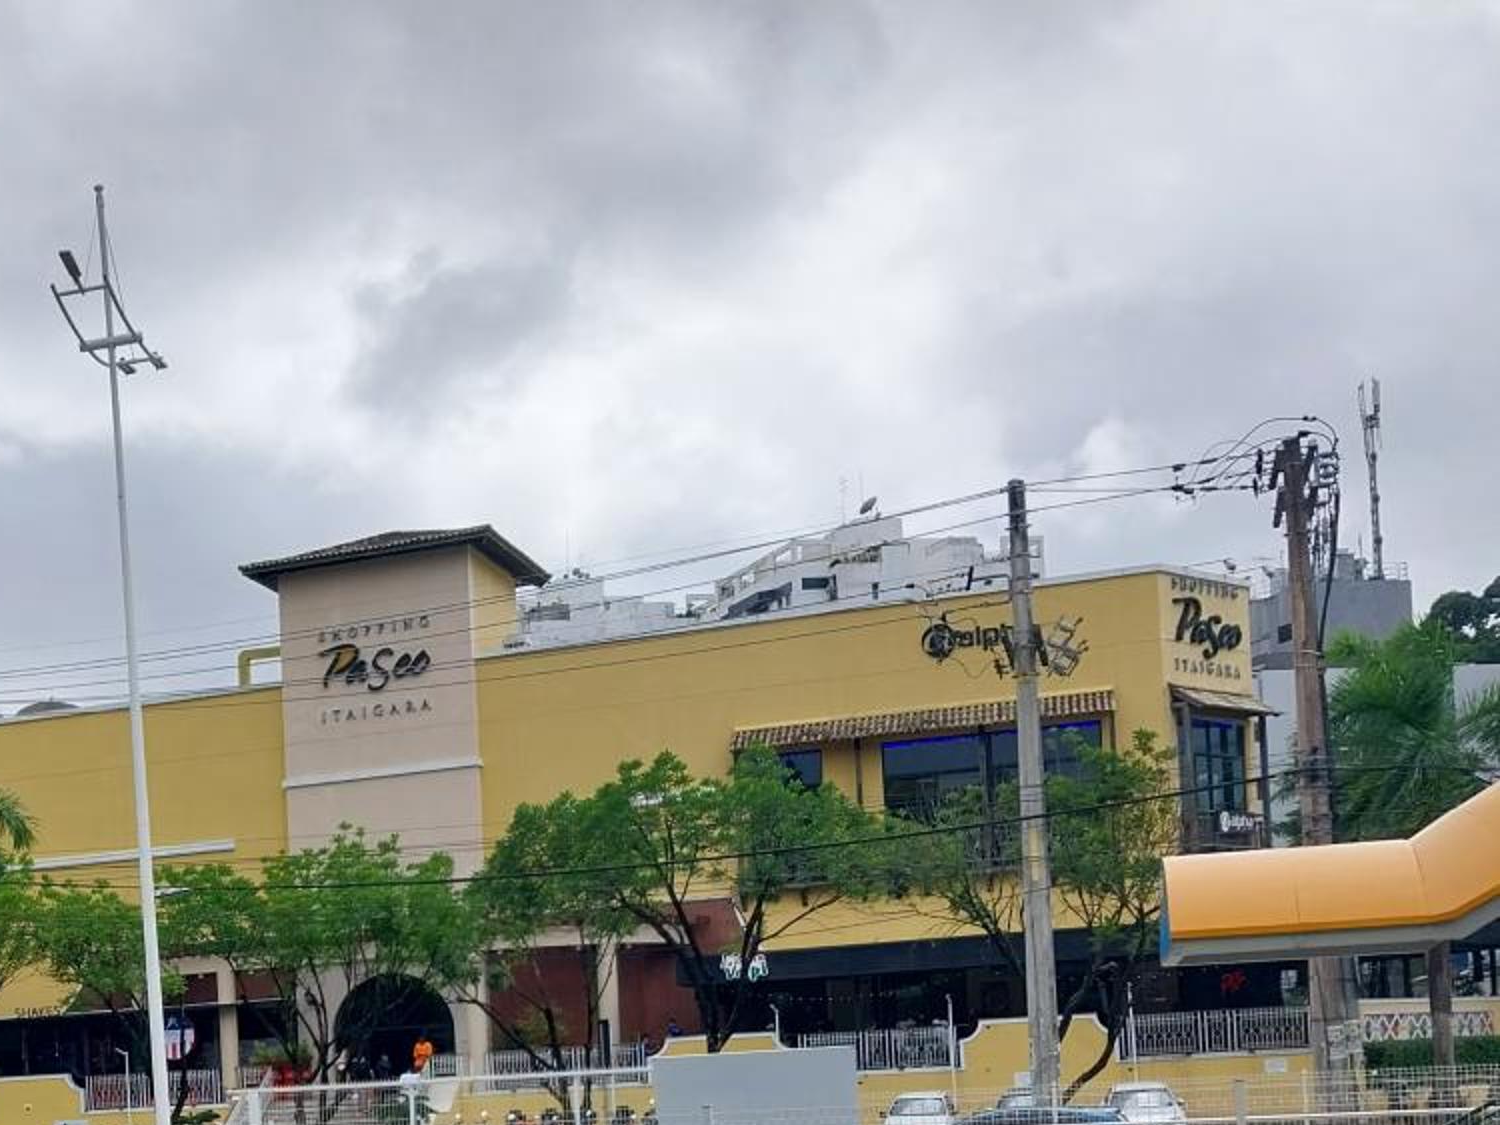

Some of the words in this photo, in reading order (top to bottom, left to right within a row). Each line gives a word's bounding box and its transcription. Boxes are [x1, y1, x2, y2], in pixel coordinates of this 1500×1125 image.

[318, 615, 430, 643] SHOPPING
[1173, 658, 1241, 680] ITAIGARA
[320, 698, 432, 725] ITAIGARA
